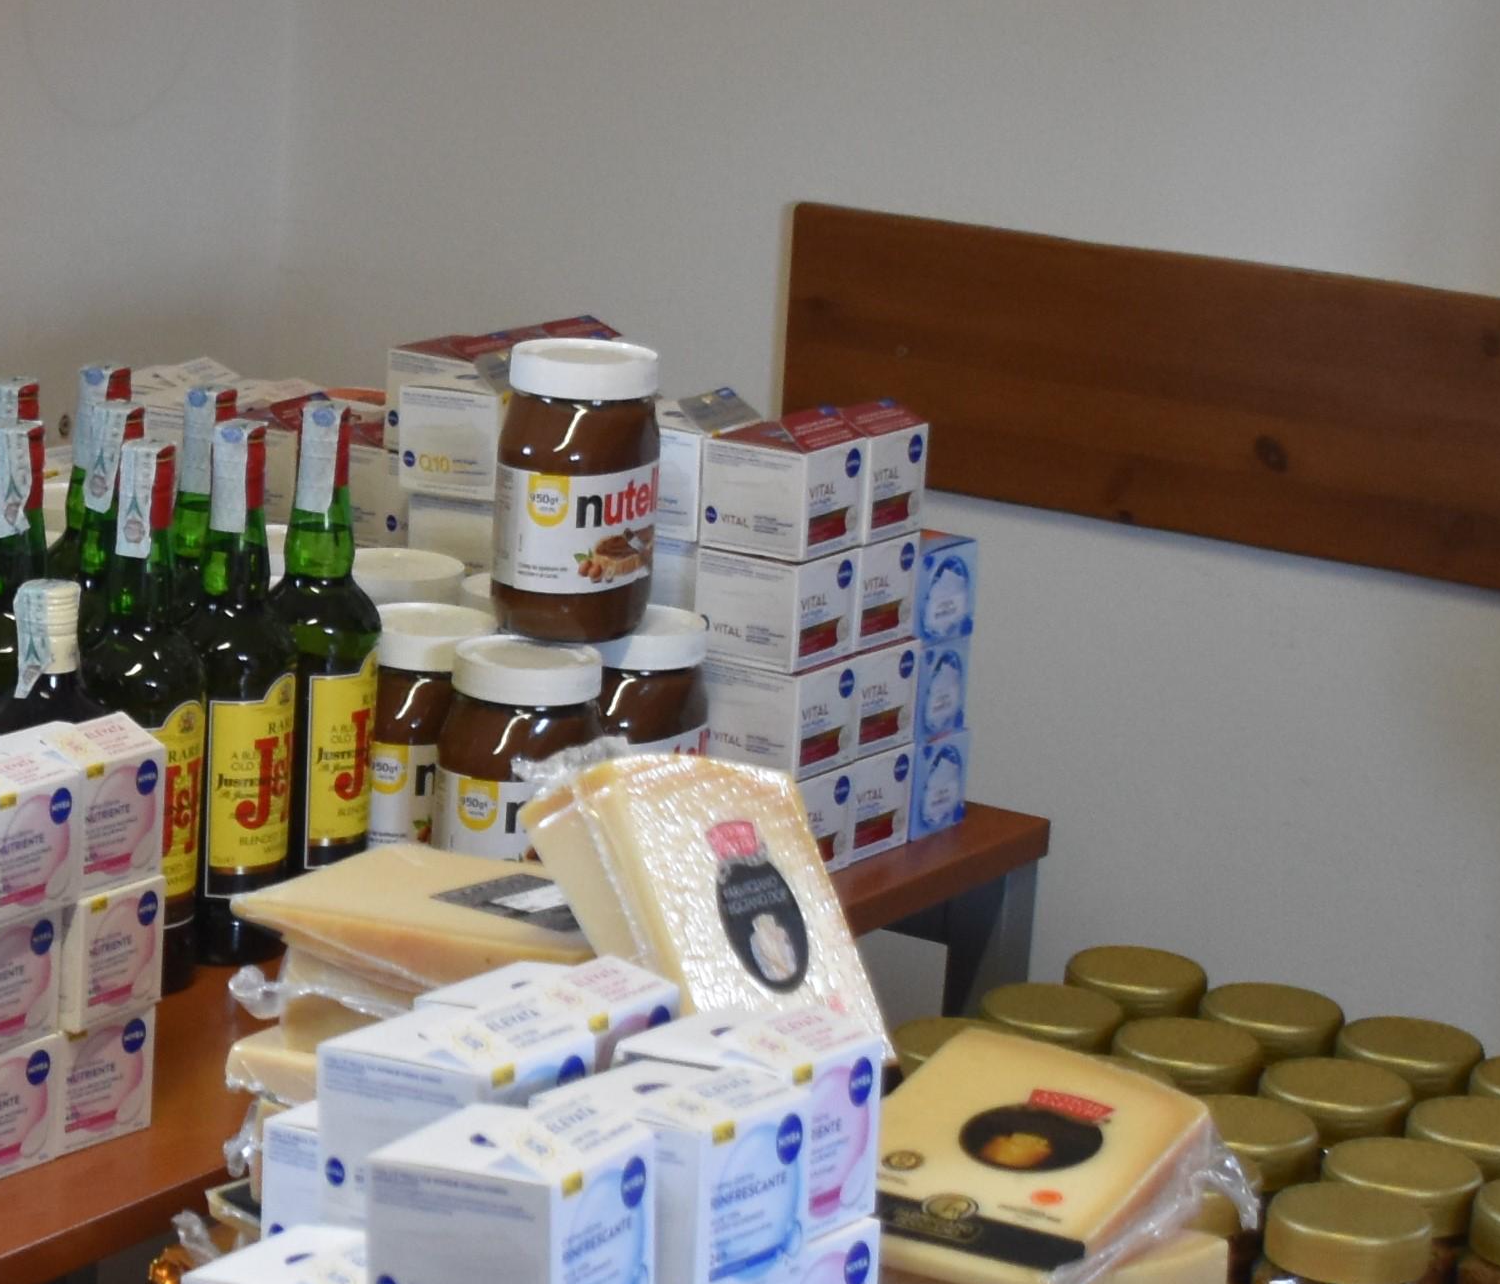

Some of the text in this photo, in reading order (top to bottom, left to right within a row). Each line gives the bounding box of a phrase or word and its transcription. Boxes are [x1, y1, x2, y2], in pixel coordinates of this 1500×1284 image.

[418, 454, 452, 474] Q10
[874, 467, 901, 484] VITAL
[809, 483, 837, 500] VITAL
[721, 513, 750, 530] VITAL
[863, 576, 891, 593] VITAL
[801, 594, 828, 612] VITAL
[713, 622, 743, 639] VITAL
[862, 683, 889, 701] VITAL
[802, 704, 830, 722] VITAL
[713, 731, 743, 748] VITAL
[857, 787, 884, 805] VITAL
